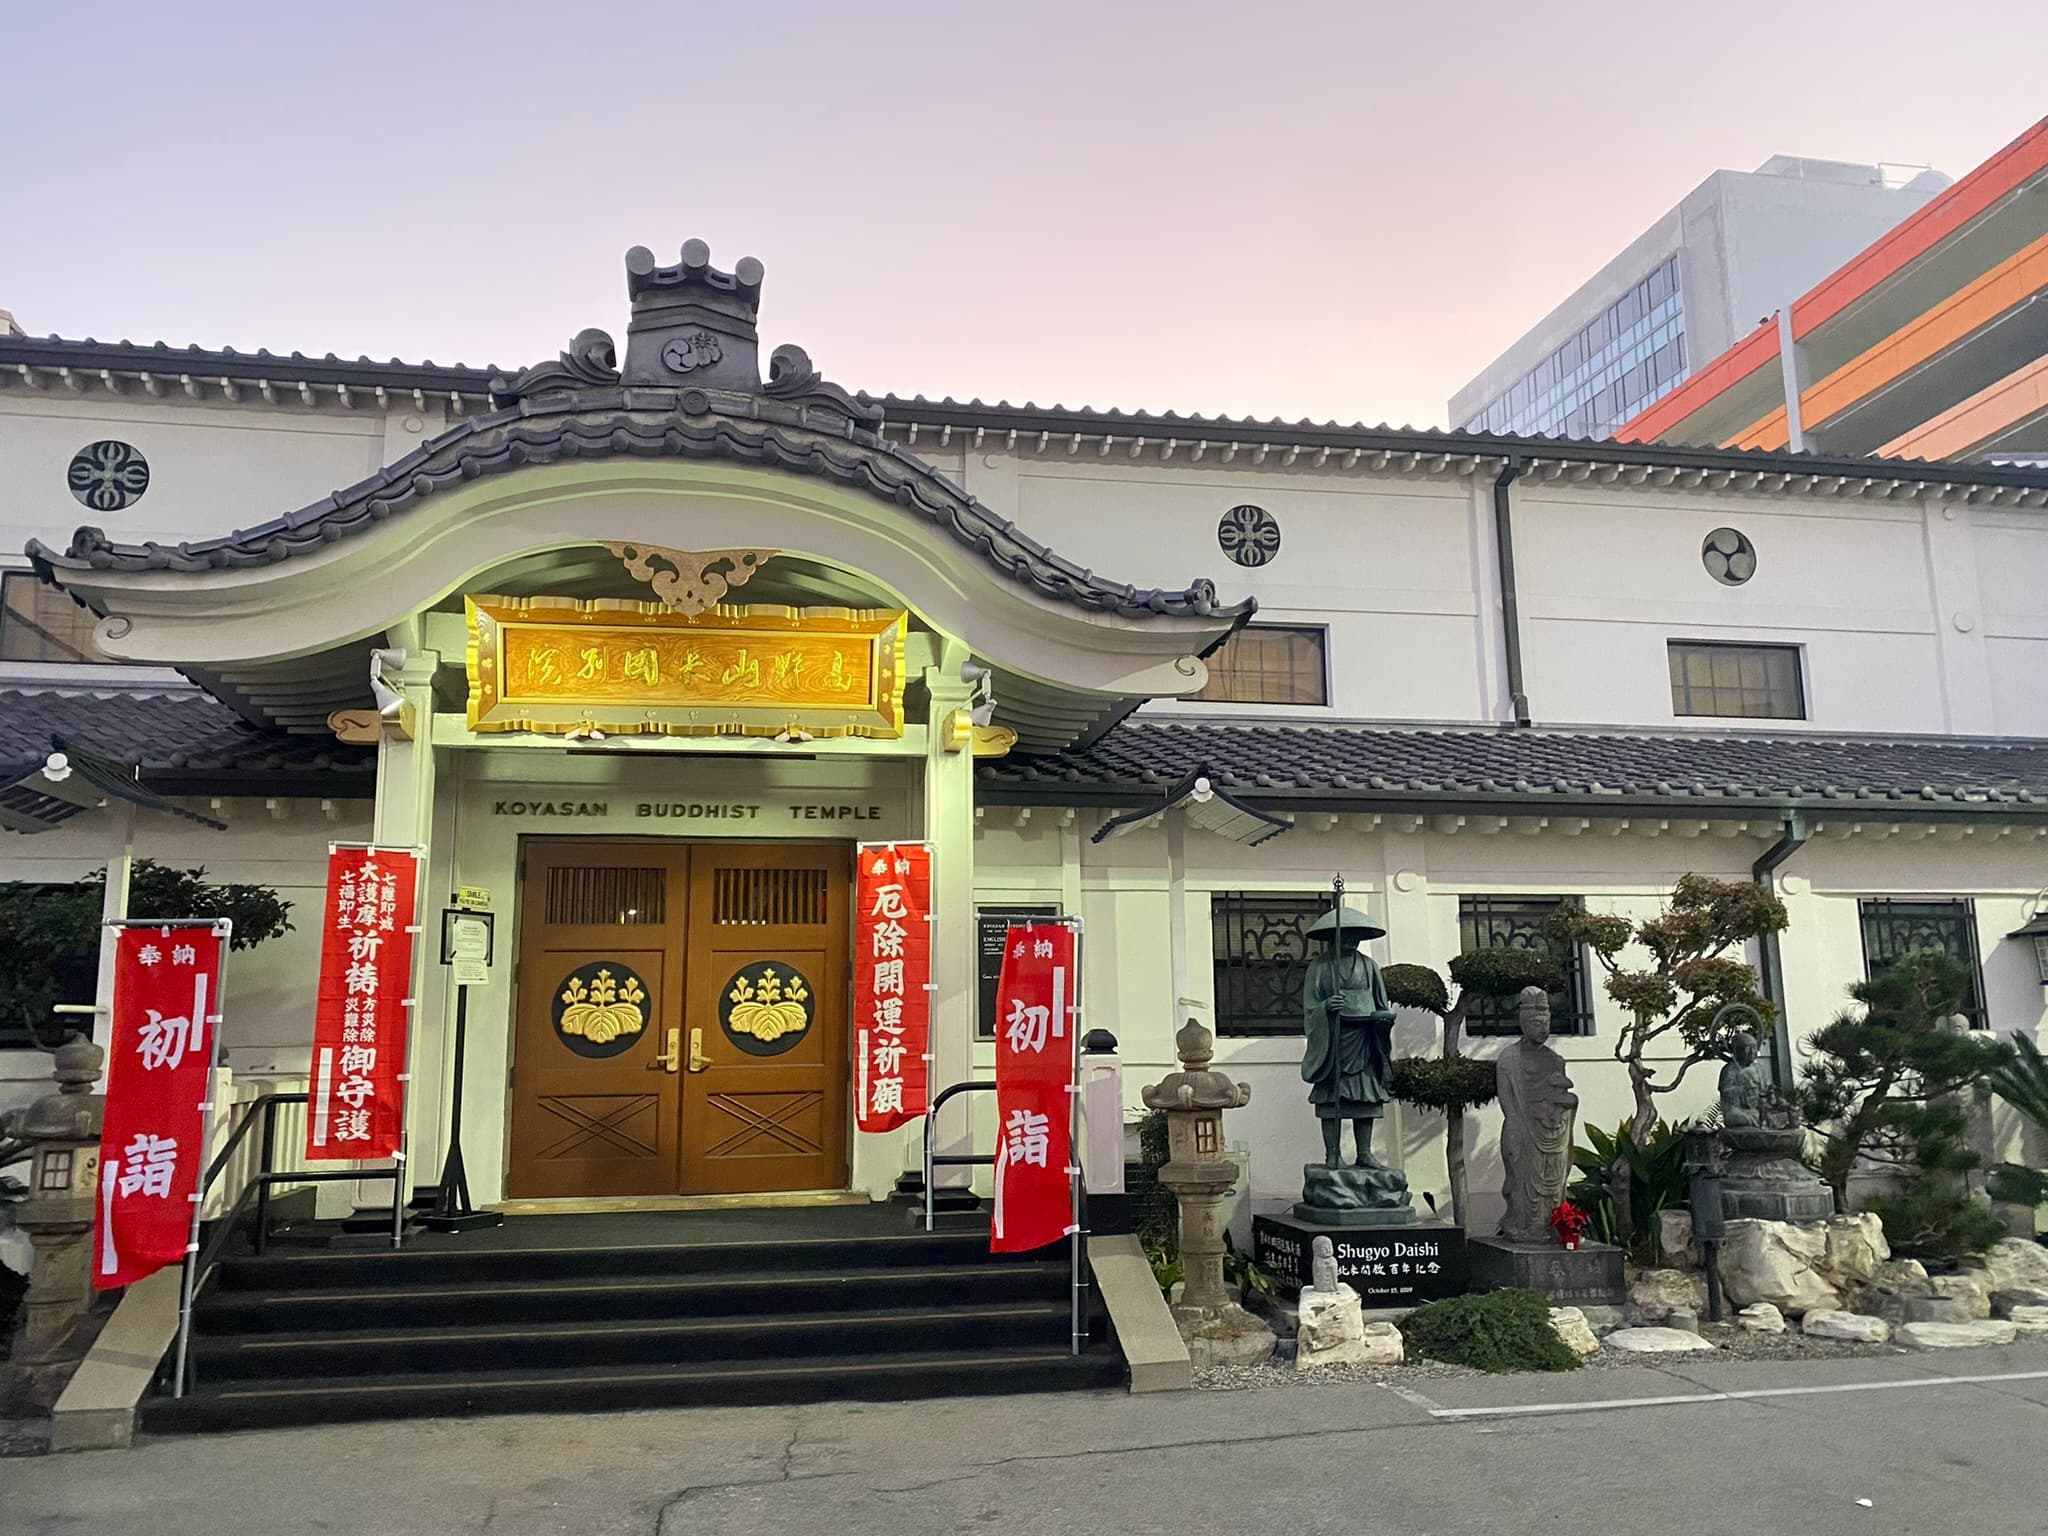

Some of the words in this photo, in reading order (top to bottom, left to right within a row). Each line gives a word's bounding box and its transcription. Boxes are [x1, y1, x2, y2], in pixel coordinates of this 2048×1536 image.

[495, 801, 608, 817] KOYASAN
[635, 802, 760, 819] BUDDHIST
[789, 805, 882, 821] TEMPLE
[137, 944, 196, 967] 奉納
[871, 883, 908, 1114] 厄除開運祈願
[1337, 1243, 1390, 1262] Shugyo
[1394, 1242, 1439, 1257] Daishi
